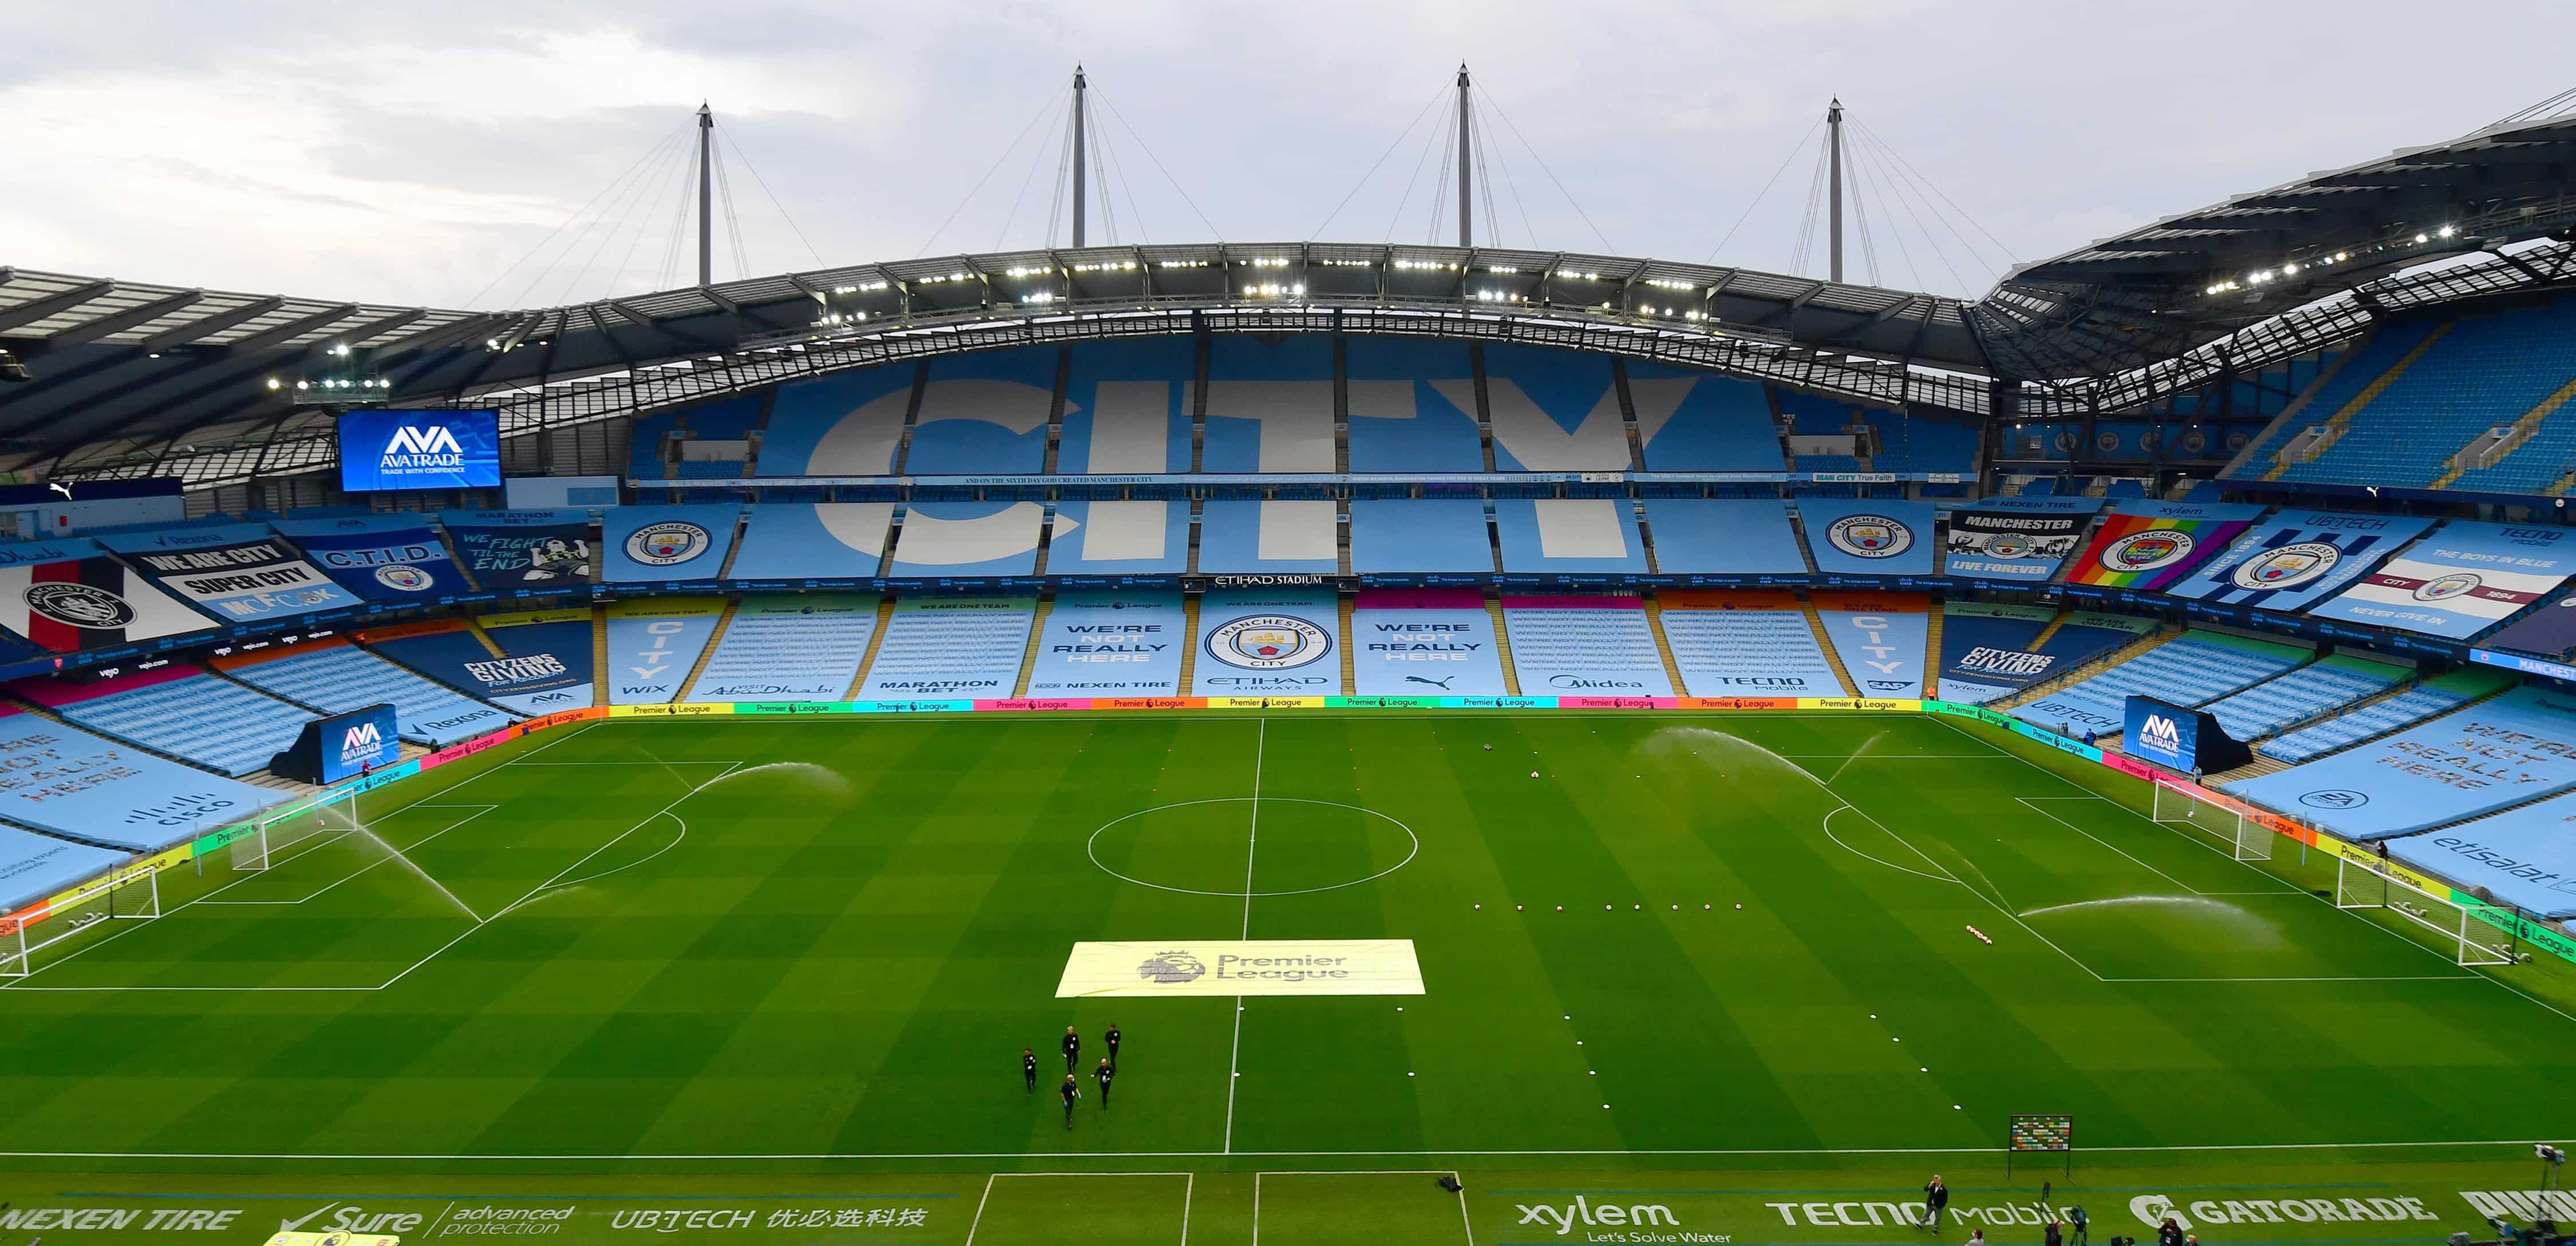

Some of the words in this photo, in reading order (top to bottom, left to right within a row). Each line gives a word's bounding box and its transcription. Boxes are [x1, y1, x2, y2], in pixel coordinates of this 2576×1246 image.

[385, 427, 463, 454] AVA
[380, 454, 464, 467] AVATRADE
[808, 378, 1698, 567] CITY
[2159, 506, 2203, 515] xylem
[1835, 516, 1902, 532] MANCHESTER
[1965, 515, 2073, 530] MANCHESTER
[636, 525, 703, 539] MANCHESTER
[2500, 527, 2565, 541] TECNO
[463, 534, 491, 543] WE
[490, 536, 553, 550] FIGHT
[2122, 531, 2190, 549] MANCHESTER
[141, 555, 191, 571] WE
[189, 551, 236, 568] ARE
[226, 544, 283, 566] CITY
[325, 546, 441, 567] C.T.I.D.
[2265, 543, 2334, 564] MANCHESTER
[2432, 549, 2460, 558] THE
[2460, 553, 2498, 562] BOYS
[2498, 554, 2516, 564] IN
[2515, 557, 2558, 568] BLUE
[474, 558, 531, 570] END
[1952, 561, 1982, 571] LIVE
[1985, 563, 2048, 574] FOREVER
[184, 574, 262, 594] SUPER
[256, 566, 312, 589] CITY
[1215, 575, 1275, 585] ETIHAD
[1277, 575, 1323, 584] STADIUM
[2244, 581, 2270, 589] CITY
[2382, 579, 2411, 587] CITY
[29, 585, 104, 605] MANCHESTER
[2486, 590, 2516, 600] 1894
[97, 619, 124, 627] CITY
[2350, 606, 2395, 618] NEVER
[2394, 612, 2427, 622] GIVE
[2427, 615, 2447, 625] IN
[1067, 625, 1162, 633] WE'RE
[1220, 618, 1317, 637] MANCHESTER
[1375, 624, 1471, 632] WE'RE
[1053, 644, 1169, 653] REALLY
[1368, 643, 1482, 651] REALLY
[464, 653, 557, 672] CITYZENS
[1067, 654, 1150, 663] HERE
[1970, 646, 2056, 664] CITYZENS
[138, 659, 168, 670] vejo.com
[472, 661, 567, 682] GIVING
[1960, 654, 2048, 674] GIVING
[100, 667, 120, 679] vejo
[879, 680, 999, 688] MARATHON
[1569, 680, 1643, 688] Midea
[1717, 677, 1805, 685] TECNO
[1947, 683, 1987, 693] xylem
[763, 685, 835, 695] Dhabi
[634, 705, 666, 715] Premier
[678, 704, 711, 715] League
[756, 705, 788, 713] Premier
[798, 704, 830, 715] League
[877, 703, 908, 711] Premier
[920, 703, 949, 712] League
[1038, 701, 1068, 710] League
[1155, 700, 1185, 708] League
[1230, 699, 1260, 707] Premier
[1271, 699, 1301, 708] League
[1347, 698, 1376, 706] Premier
[1388, 698, 1418, 708] League
[1464, 698, 1494, 706] Premier
[1505, 698, 1535, 708] League
[1744, 700, 1774, 709] League
[1820, 700, 1852, 708] Premier
[1864, 700, 1897, 710] League
[424, 709, 499, 730] Rexona
[554, 712, 584, 724] League
[1947, 704, 1975, 716] Premier
[1983, 711, 2006, 725] League
[2142, 714, 2179, 742] AVA
[343, 723, 381, 751] AVA
[2033, 728, 2054, 744] Premier
[2061, 738, 2085, 755] League
[2139, 732, 2180, 753] AVATRADE
[440, 748, 464, 763] Premier
[472, 738, 495, 752] League
[2121, 760, 2147, 779] Premier
[158, 801, 235, 826] CISCO
[2263, 814, 2295, 835] League
[217, 826, 250, 845] Premier
[2433, 837, 2559, 884] etisalat
[1217, 953, 1348, 967] Premier
[1217, 968, 1349, 981] League
[452, 1206, 575, 1221] advanced
[1515, 1195, 1680, 1235] xylem
[1765, 1202, 1941, 1226] TECNO
[2191, 1196, 2439, 1224] GATORADE
[0, 1209, 143, 1230] NEXEN
[142, 1209, 244, 1231] TIRE
[321, 1206, 423, 1233] Sure
[767, 1207, 930, 1229] 优必选科技
[439, 1221, 560, 1237] protection
[1587, 1231, 1627, 1243] Let's
[1630, 1231, 1677, 1243] Solve
[1679, 1232, 1731, 1244] Water
